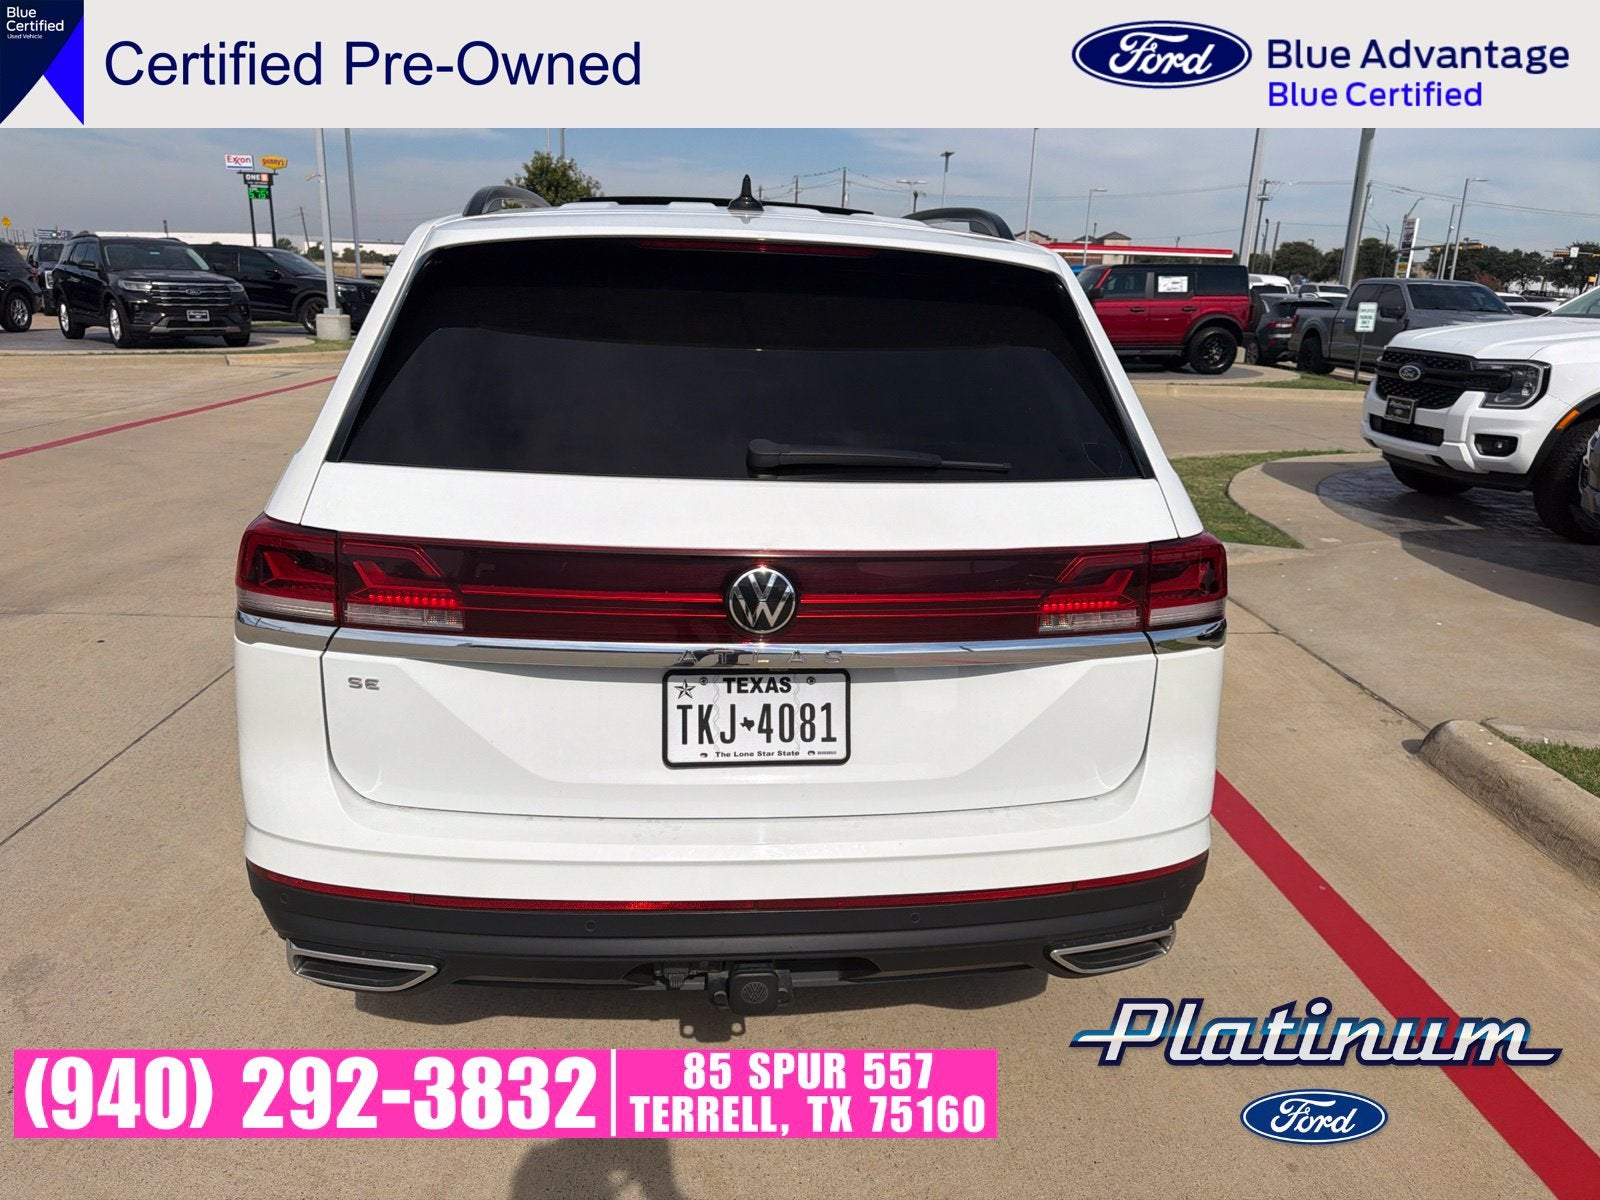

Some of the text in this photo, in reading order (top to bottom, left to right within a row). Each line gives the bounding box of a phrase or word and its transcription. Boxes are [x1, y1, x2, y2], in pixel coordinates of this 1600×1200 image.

[226, 155, 252, 165] Exxon
[245, 173, 260, 181] ONE
[678, 649, 844, 665] ATLAS
[348, 677, 380, 691] SE
[722, 676, 793, 695] TEXAS
